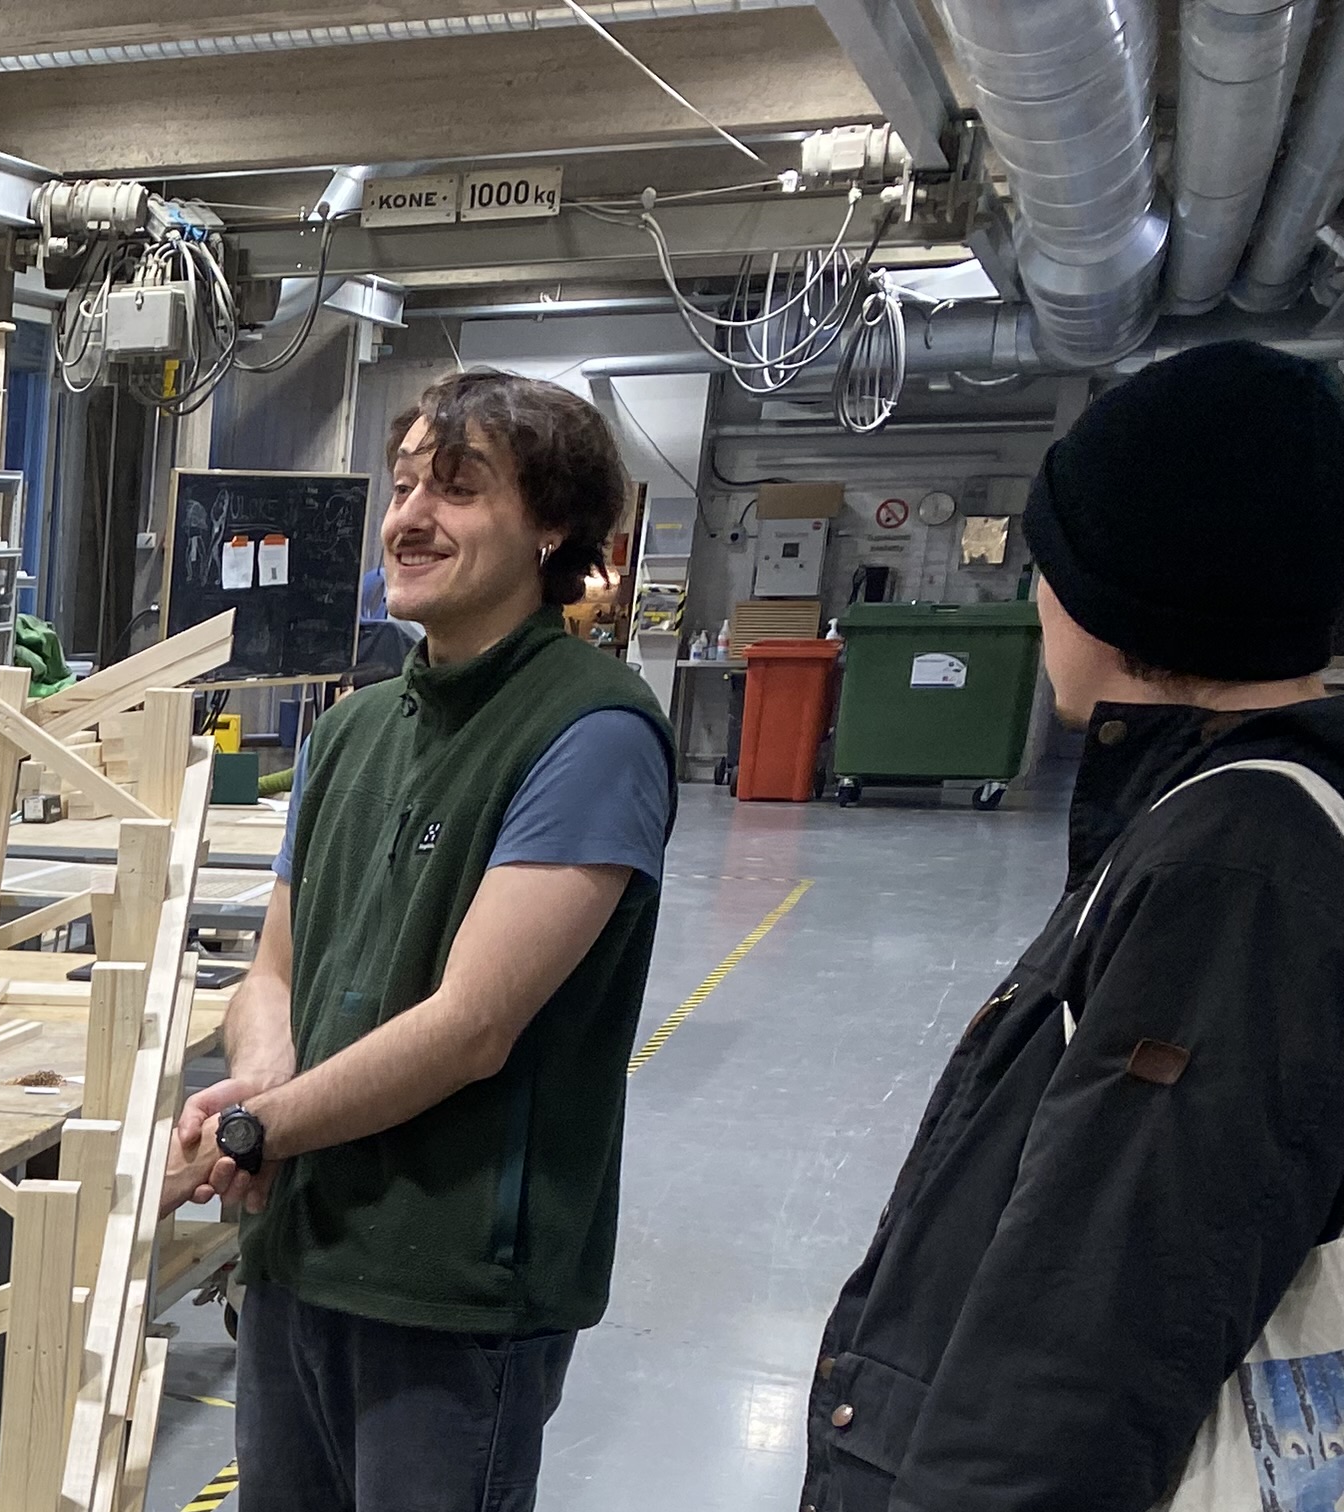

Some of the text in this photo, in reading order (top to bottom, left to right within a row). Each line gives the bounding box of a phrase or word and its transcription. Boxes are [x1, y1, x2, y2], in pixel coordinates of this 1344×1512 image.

[379, 191, 437, 210] KONE
[469, 179, 555, 210] 1000 kg
